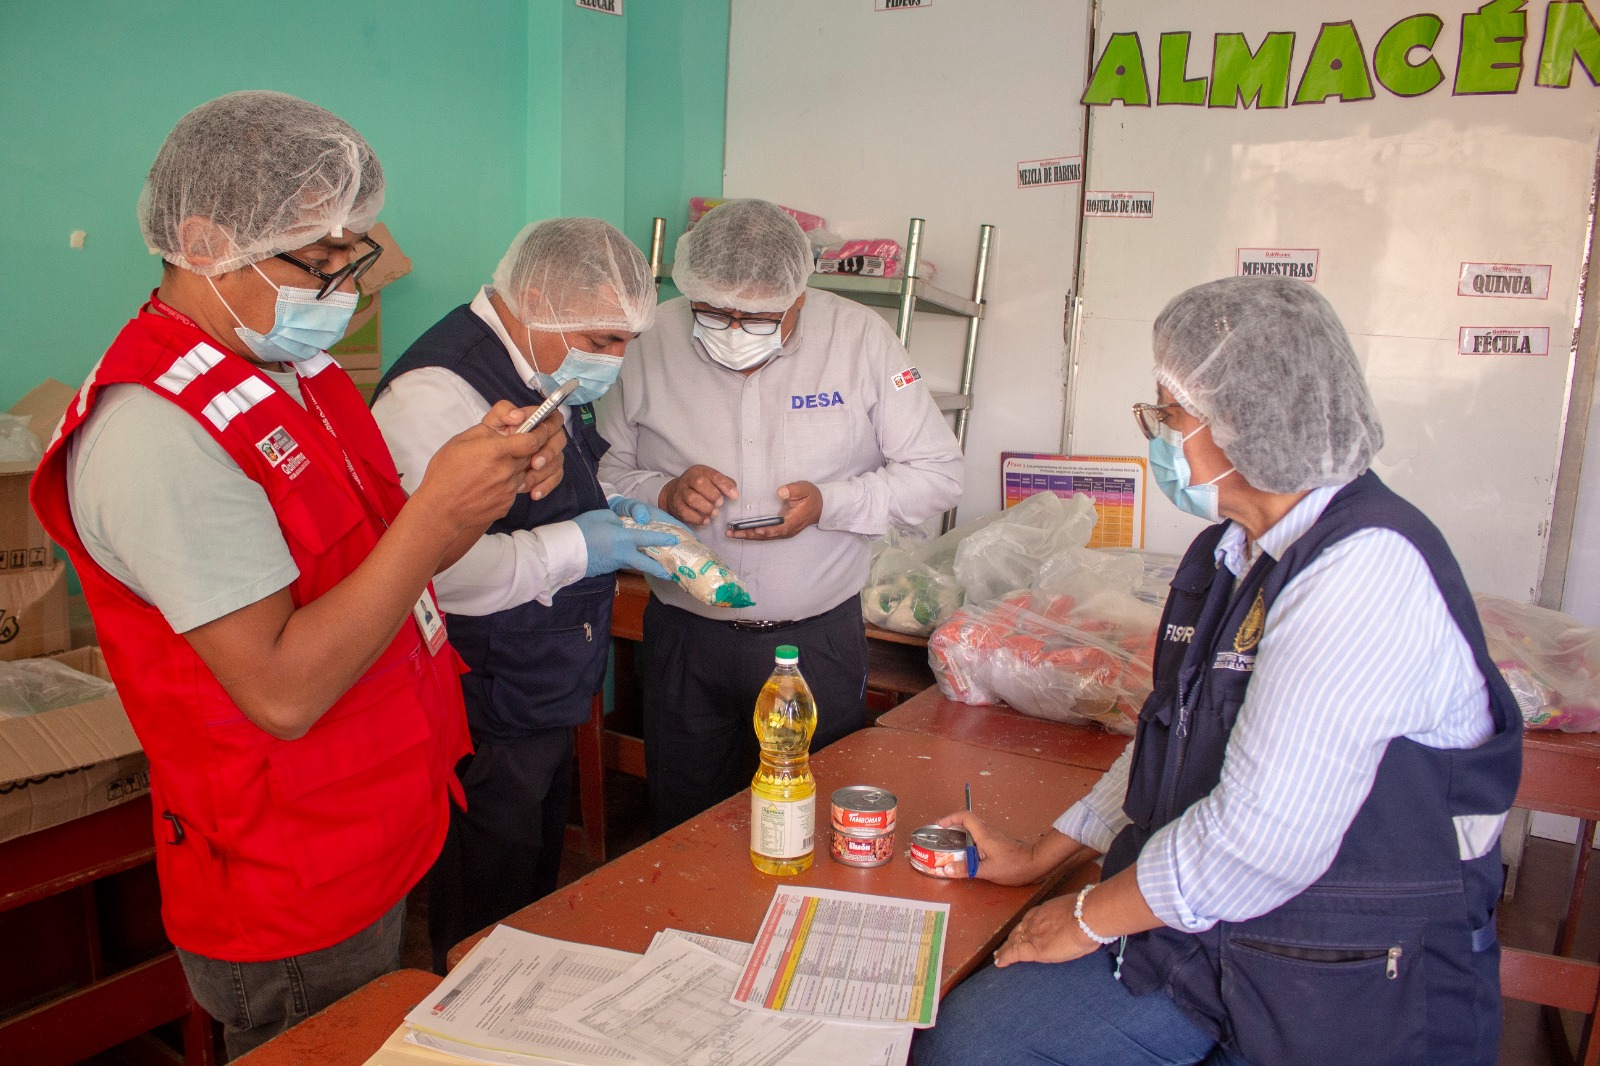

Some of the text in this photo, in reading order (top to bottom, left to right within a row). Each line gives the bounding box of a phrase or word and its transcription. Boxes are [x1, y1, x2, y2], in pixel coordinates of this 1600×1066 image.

[1080, 0, 1600, 109] ALMACÉN
[1019, 163, 1081, 186] MEZCLA DE HARINAS
[1085, 199, 1152, 215] HOJUELAS DE AVENA
[1242, 262, 1314, 278] MENESTRAS
[1472, 274, 1533, 295] QUINUA
[1473, 331, 1532, 354] FÉCULA
[791, 391, 845, 410] DESA
